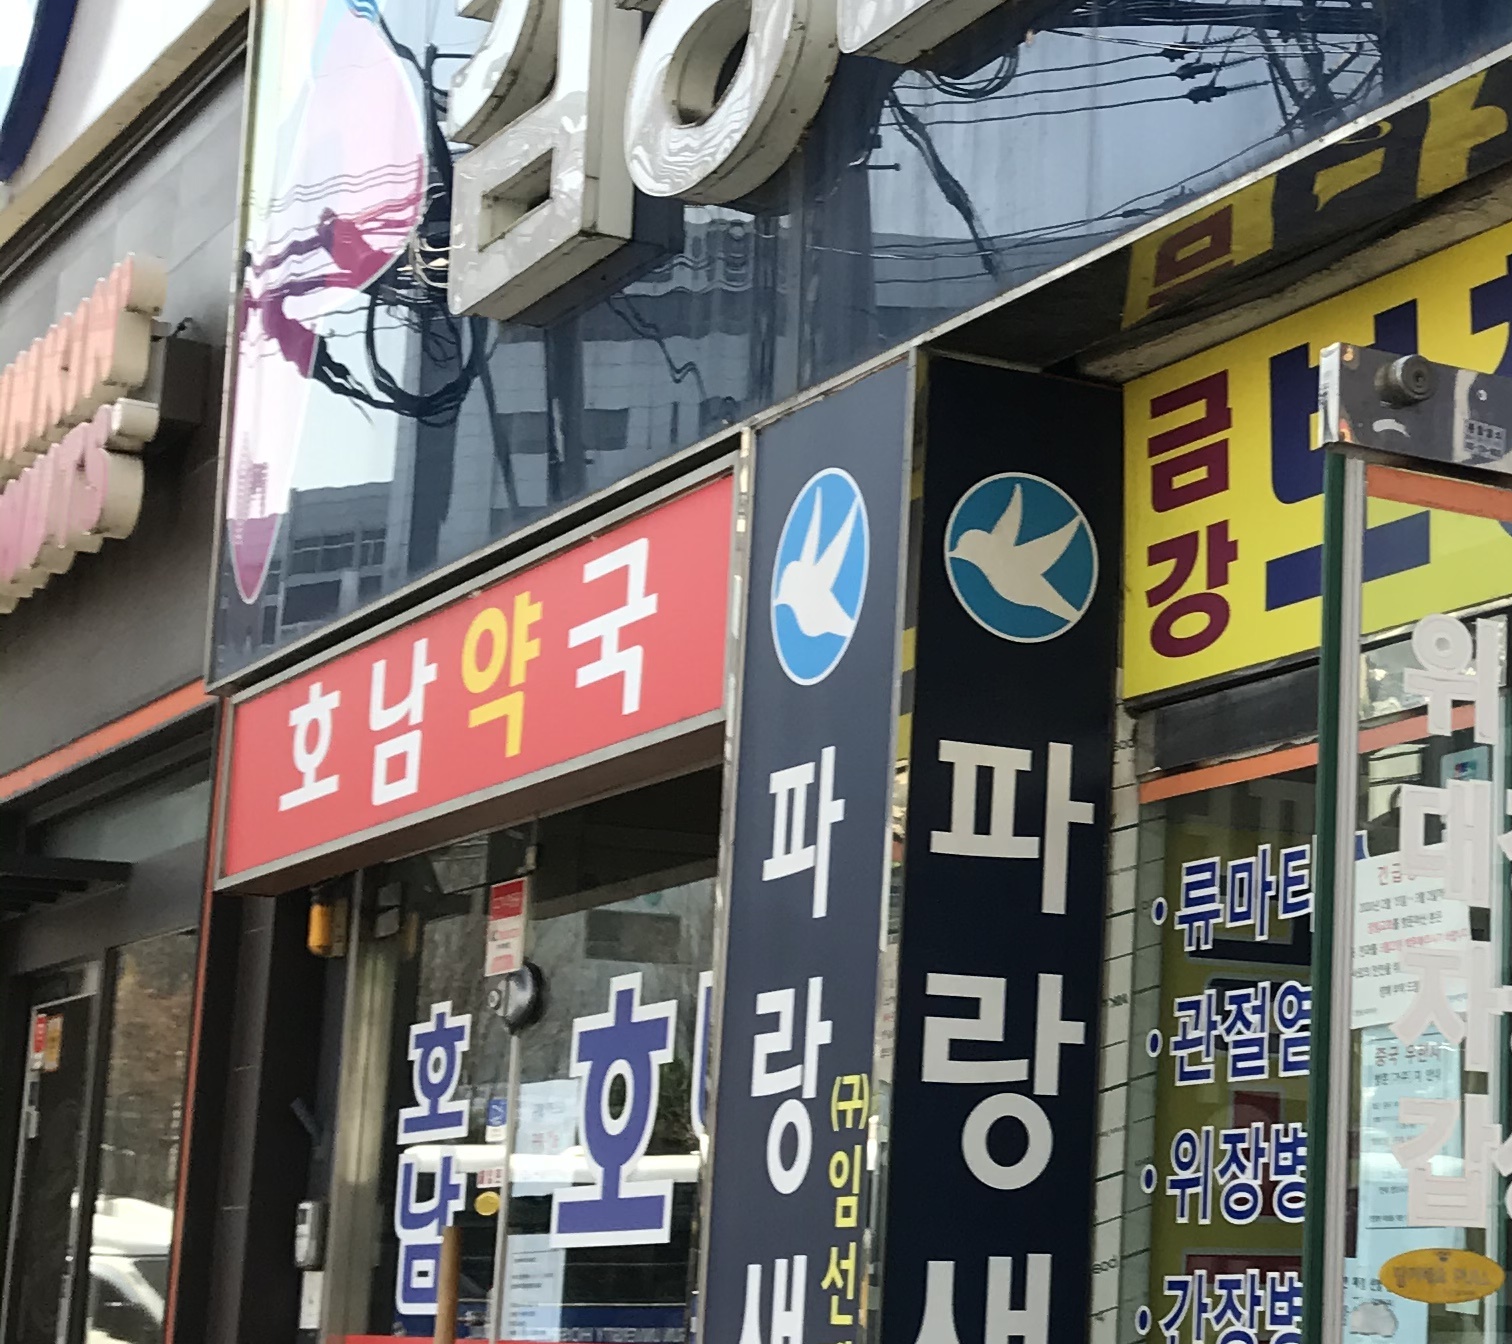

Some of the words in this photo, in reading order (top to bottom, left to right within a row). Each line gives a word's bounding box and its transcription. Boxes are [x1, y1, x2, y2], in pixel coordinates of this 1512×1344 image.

[1145, 369, 1238, 658] 금강
[278, 537, 657, 812] 호남약국
[1403, 613, 1499, 745] 위
